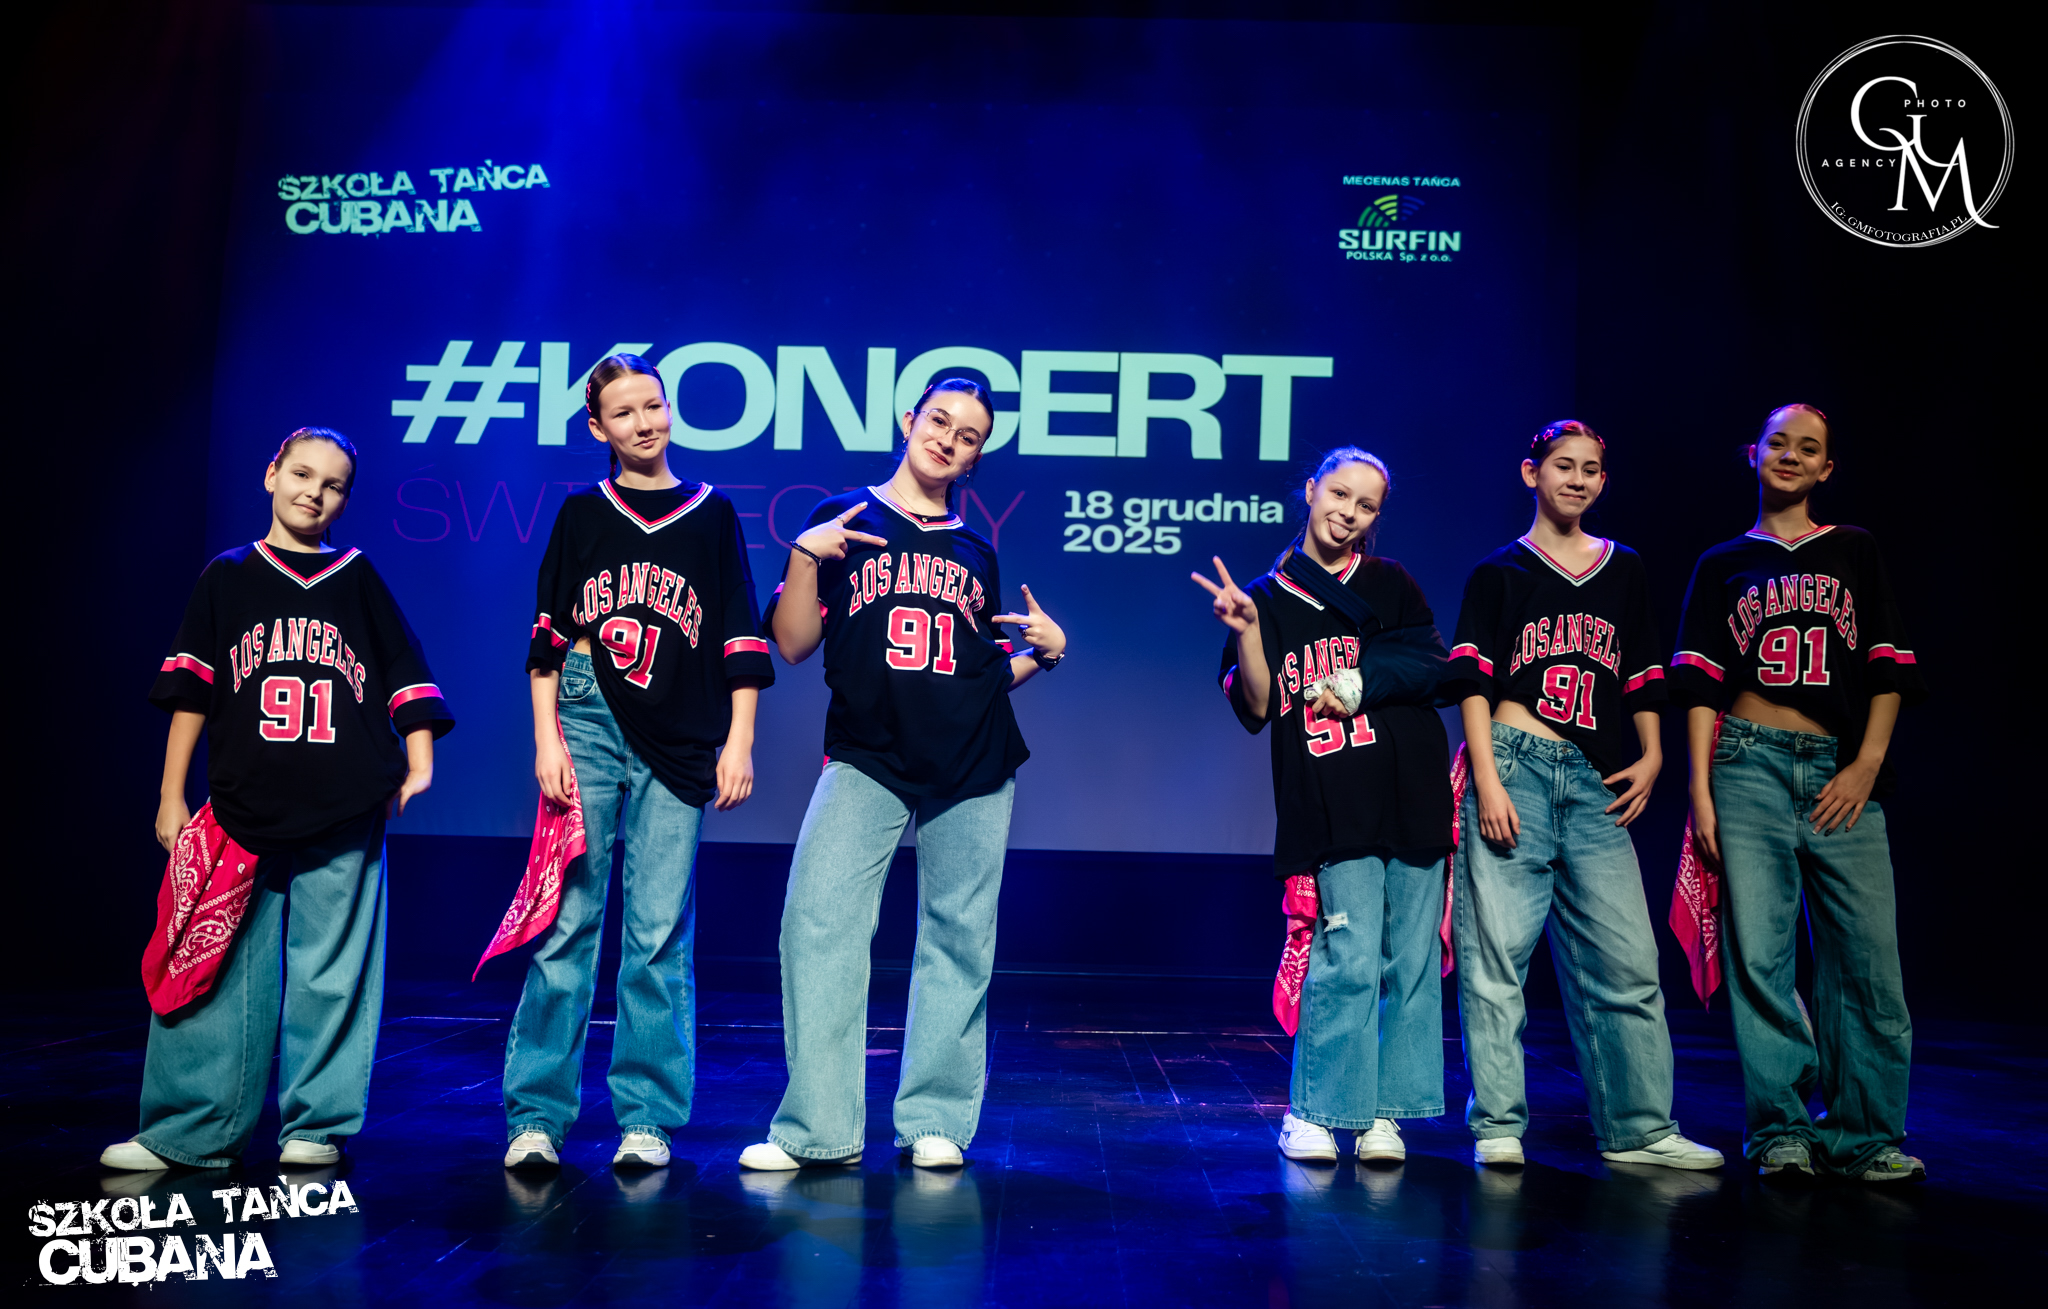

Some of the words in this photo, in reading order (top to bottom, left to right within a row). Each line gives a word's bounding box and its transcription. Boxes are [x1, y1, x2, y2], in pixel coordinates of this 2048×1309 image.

[278, 170, 417, 201] SZKOŁA
[429, 159, 551, 193] TAŃCA
[1342, 175, 1411, 186] MECENAS
[1412, 174, 1462, 187] TAŃCA
[285, 199, 483, 236] CUBANA
[1338, 228, 1462, 252] SURFIN
[1346, 250, 1394, 261] POLSKA
[1399, 251, 1418, 263] Sp.
[1420, 253, 1428, 262] z
[1429, 253, 1453, 262] o.o.
[391, 340, 1334, 461] #KONCERT
[1063, 523, 1182, 555] 2025
[1064, 490, 1114, 519] 18
[1122, 492, 1285, 527] grudnia
[617, 561, 703, 649] ANGELES
[849, 552, 892, 617] LOS
[1728, 585, 1763, 656] LOS
[1765, 573, 1858, 651] ANGELES
[230, 622, 265, 694] LOS
[267, 617, 367, 704] ANGELES
[599, 616, 662, 690] 91
[886, 606, 957, 675] 91
[1510, 616, 1550, 676] LOS
[1758, 625, 1830, 686] 91
[259, 675, 336, 744] 91
[1277, 651, 1301, 717] LS
[1536, 664, 1597, 731] 91
[1304, 700, 1377, 758] 91
